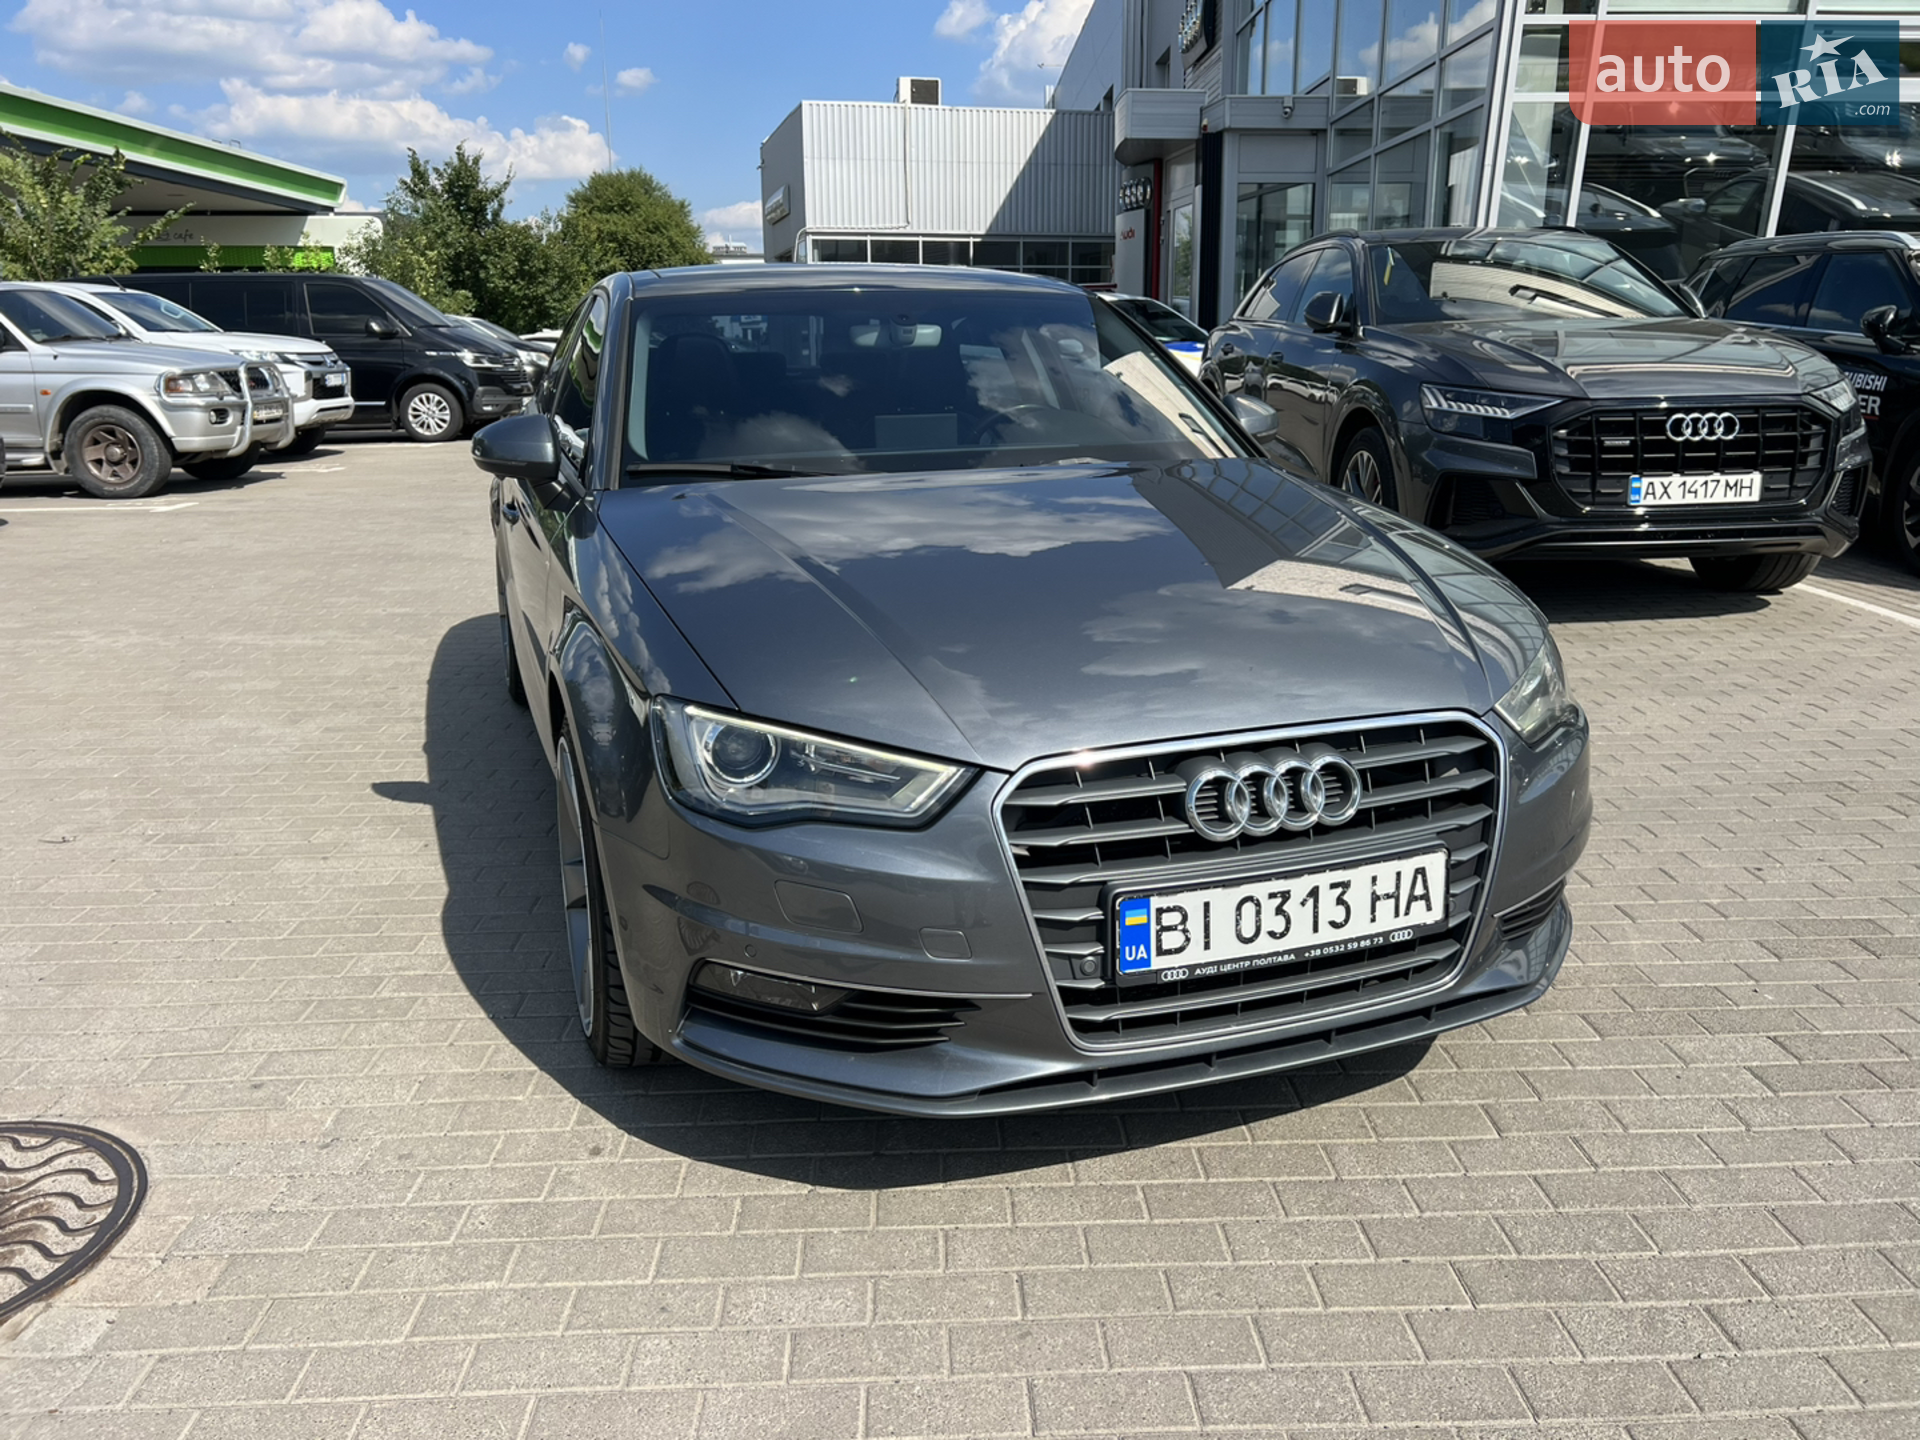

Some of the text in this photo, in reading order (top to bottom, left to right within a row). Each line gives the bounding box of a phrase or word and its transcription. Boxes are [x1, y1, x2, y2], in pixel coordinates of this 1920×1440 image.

[173, 229, 194, 242] cafe
[1643, 478, 1754, 500] AX 1417 MH
[1155, 866, 1433, 957] BI 0313 HA
[1124, 944, 1148, 961] UA
[1194, 965, 1218, 976] АУДІ
[1219, 961, 1251, 973] ЦЕНТР
[1252, 953, 1296, 967] ПОЛТАВА
[1322, 944, 1345, 955] 0532
[1347, 941, 1358, 950] 59
[1373, 936, 1384, 944] 73
